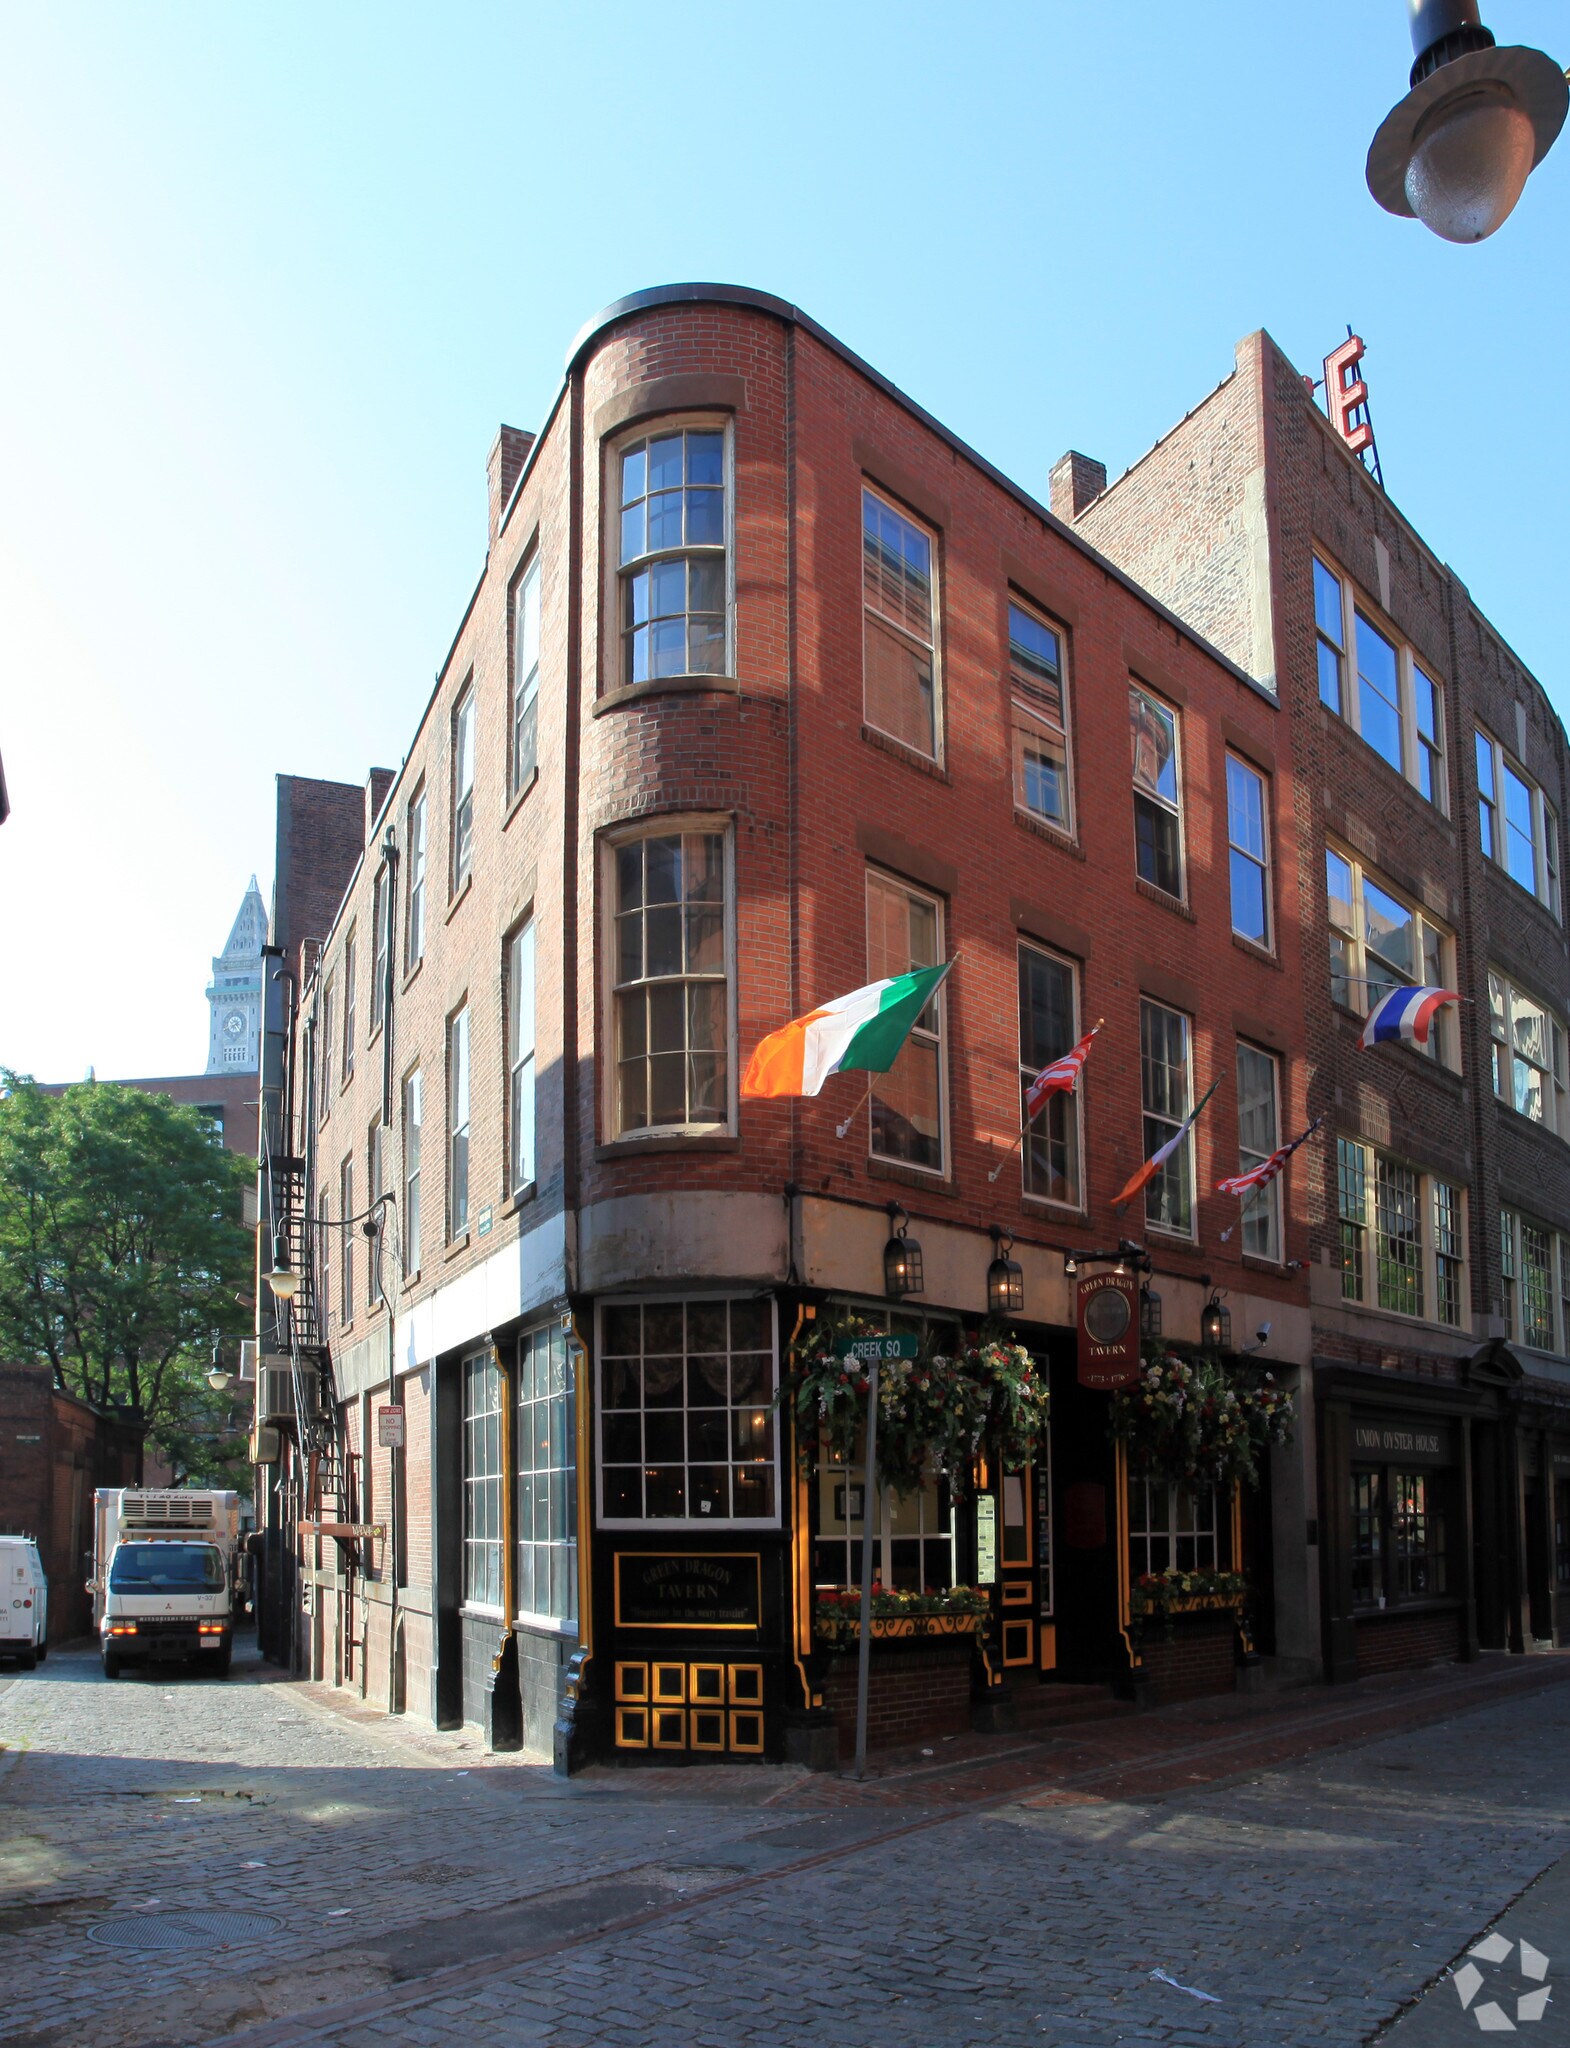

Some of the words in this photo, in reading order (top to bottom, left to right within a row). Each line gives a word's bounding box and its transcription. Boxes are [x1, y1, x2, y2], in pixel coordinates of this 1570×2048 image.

[1080, 1278, 1104, 1294] GREEN
[1105, 1276, 1135, 1291] DRAGON
[851, 1341, 882, 1358] CREEK
[885, 1340, 901, 1357] SQ
[1089, 1344, 1126, 1356] TAVERN
[1355, 1428, 1380, 1448] UNION
[1383, 1431, 1414, 1451] OYSTER
[1415, 1434, 1440, 1452] HOUSE
[642, 1560, 680, 1585] GREEN
[685, 1559, 732, 1585] DRAGON
[657, 1584, 719, 1599] TAVERN
